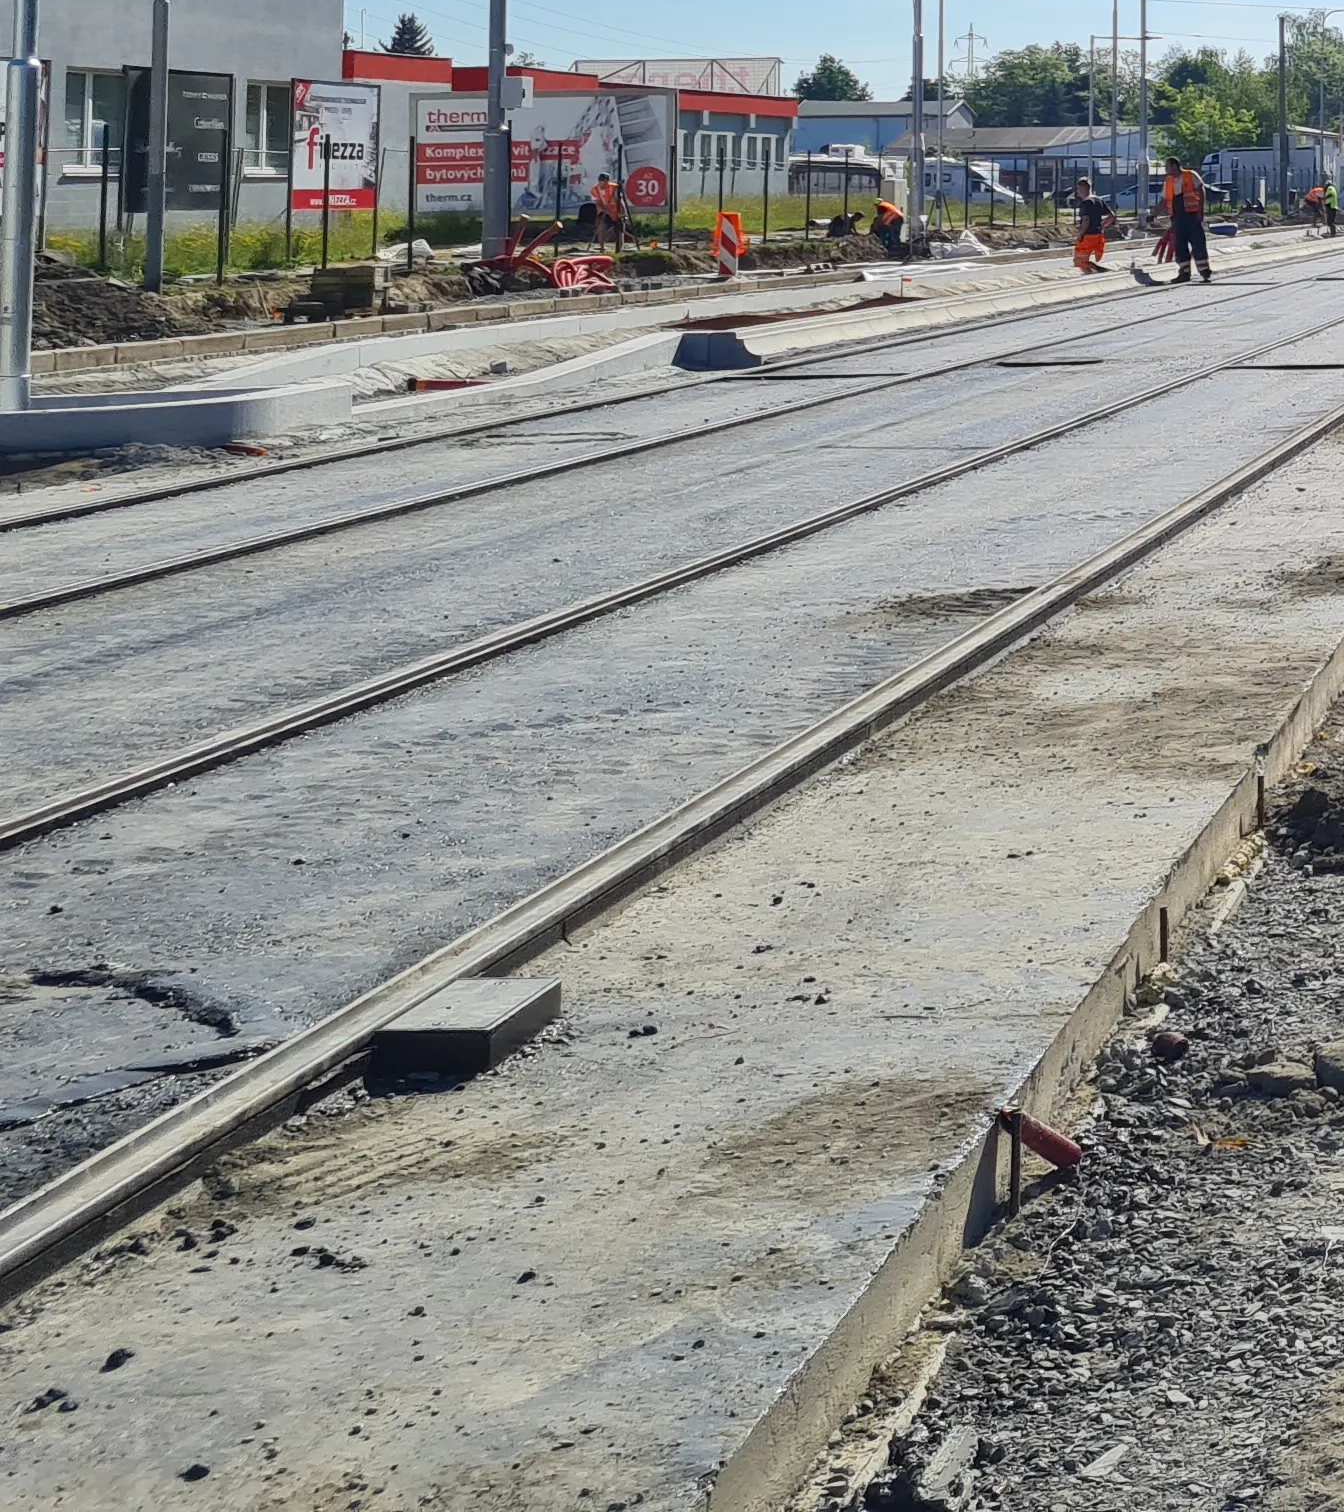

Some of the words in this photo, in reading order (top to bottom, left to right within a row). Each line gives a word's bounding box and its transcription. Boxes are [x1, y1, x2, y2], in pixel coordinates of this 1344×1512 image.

[427, 108, 487, 124] therm
[307, 127, 364, 169] fiezza
[425, 145, 485, 159] Komplex
[635, 179, 659, 196] 30
[425, 193, 472, 203] therm.cz
